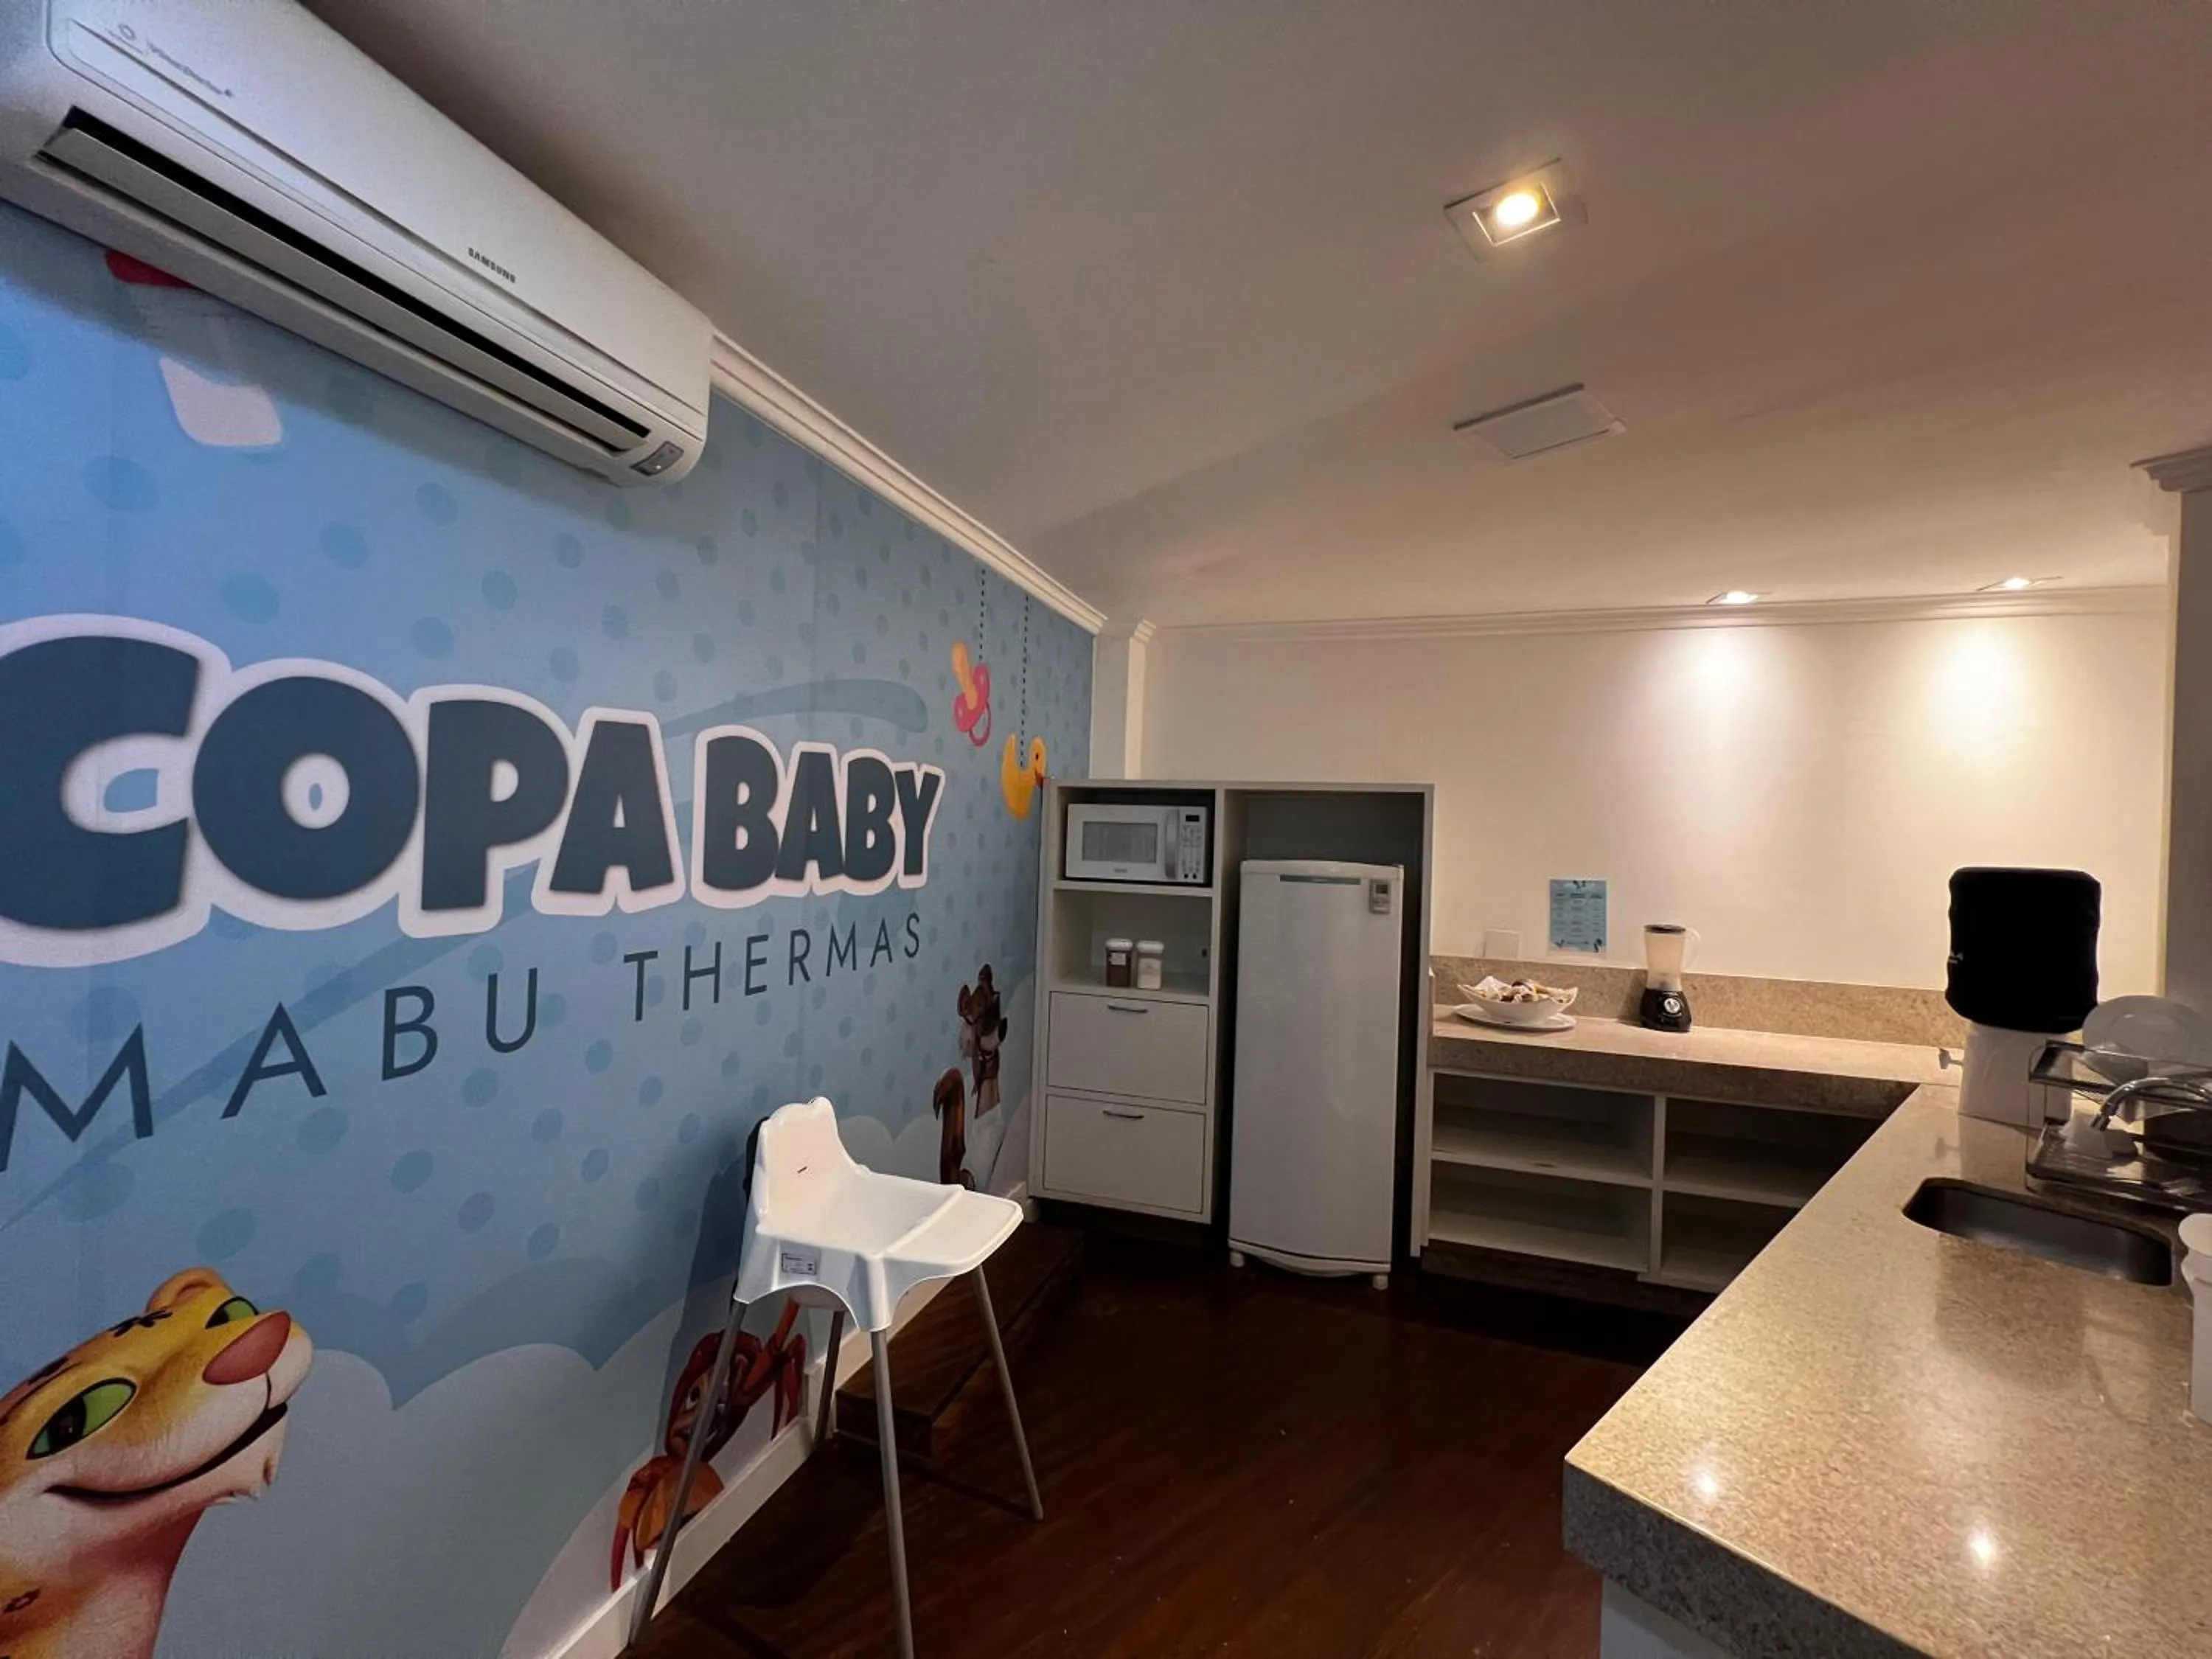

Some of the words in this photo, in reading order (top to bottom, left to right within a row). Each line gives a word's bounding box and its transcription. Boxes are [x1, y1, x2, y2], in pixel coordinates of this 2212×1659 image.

[468, 247, 516, 283] SAMSUNG
[0, 635, 675, 931] COPA
[702, 734, 942, 891] BABY
[0, 967, 538, 1174] MABU
[623, 911, 922, 1022] THERMAS
